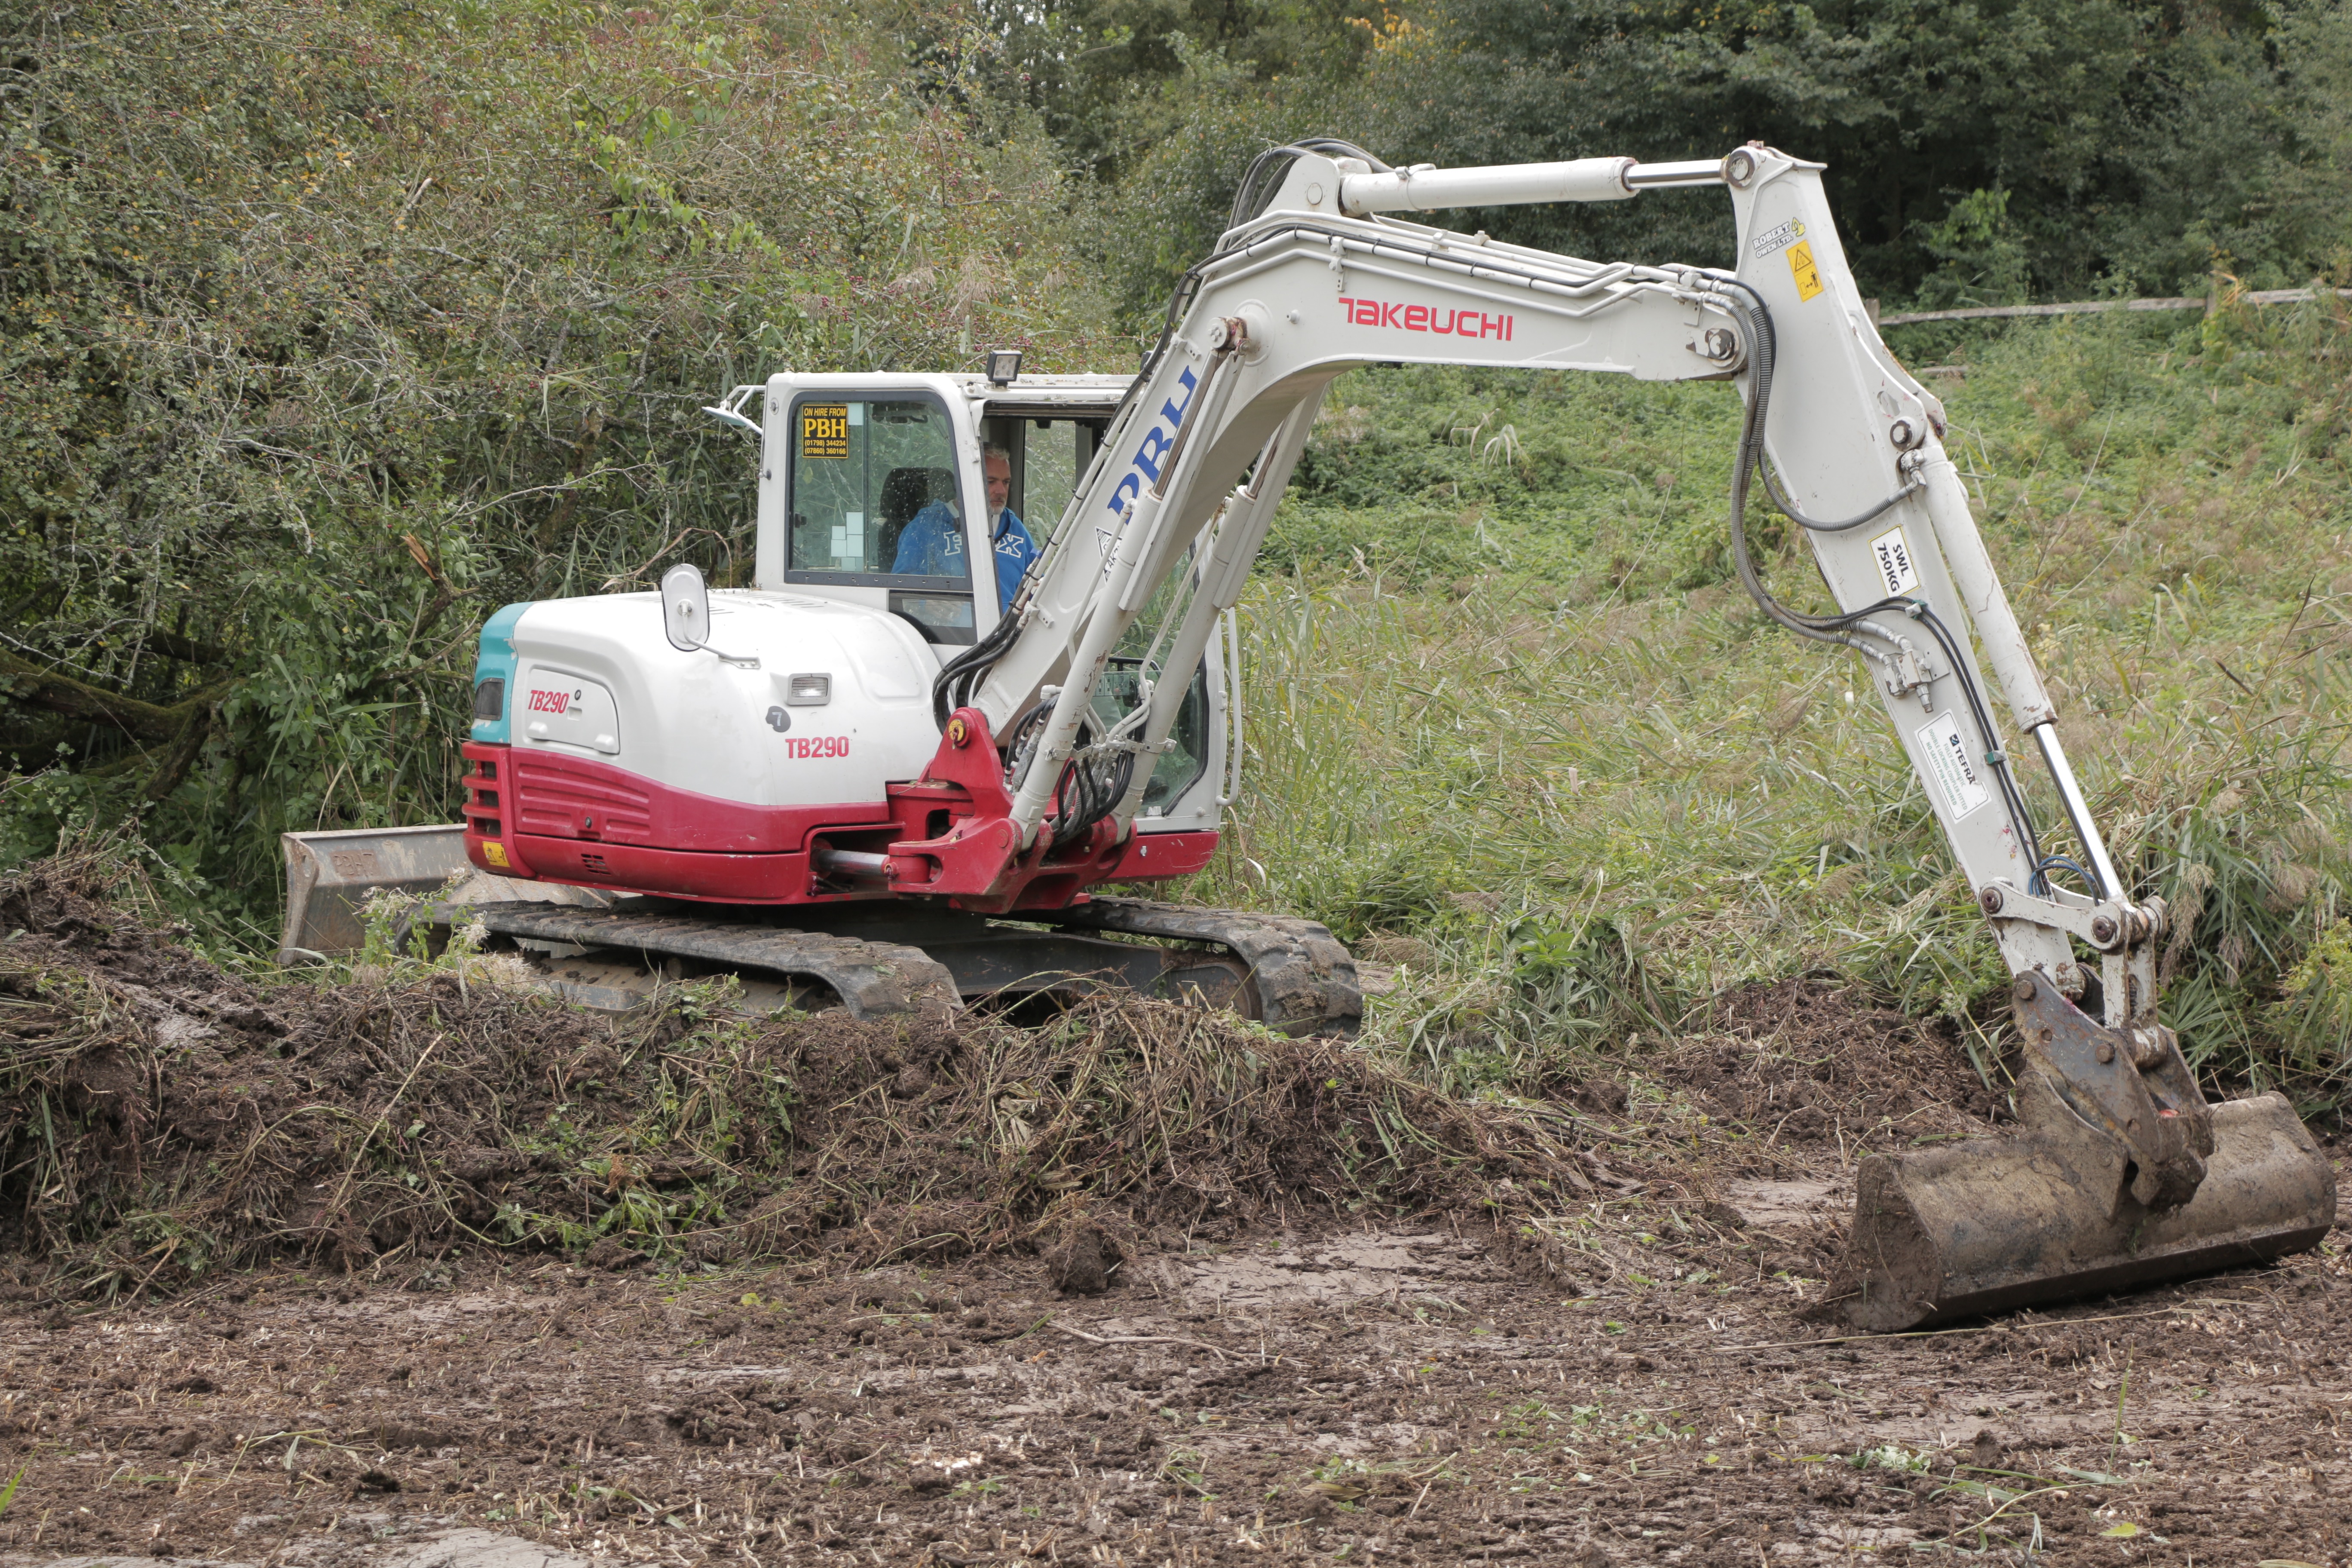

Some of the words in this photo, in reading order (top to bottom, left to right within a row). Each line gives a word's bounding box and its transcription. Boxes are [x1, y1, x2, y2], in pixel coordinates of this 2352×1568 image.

[1752, 221, 1790, 250] ROBERT
[1756, 241, 1778, 258] OWEN
[1777, 234, 1794, 248] LTD.
[804, 408, 813, 416] ON
[814, 408, 828, 416] HIRE
[829, 408, 846, 416] FROM
[804, 418, 845, 438] PBH
[1877, 542, 1900, 592] 750KG
[1893, 544, 1909, 577] SWL
[528, 689, 570, 714] TB290
[772, 712, 782, 726] 7
[785, 736, 849, 759] TB290
[1926, 741, 1932, 750] NO
[1929, 750, 1941, 769] SAFETY
[1943, 779, 1957, 805] REQUIRED
[1928, 729, 1940, 749] DOUBLE
[1937, 749, 1950, 770] LOCKING
[1947, 770, 1960, 793] COUPLER
[1957, 793, 1967, 810] FITTED
[1944, 743, 1953, 758] FULLY
[1950, 759, 1966, 787] AUTOMATIC
[1955, 747, 1975, 785] TEFRA
